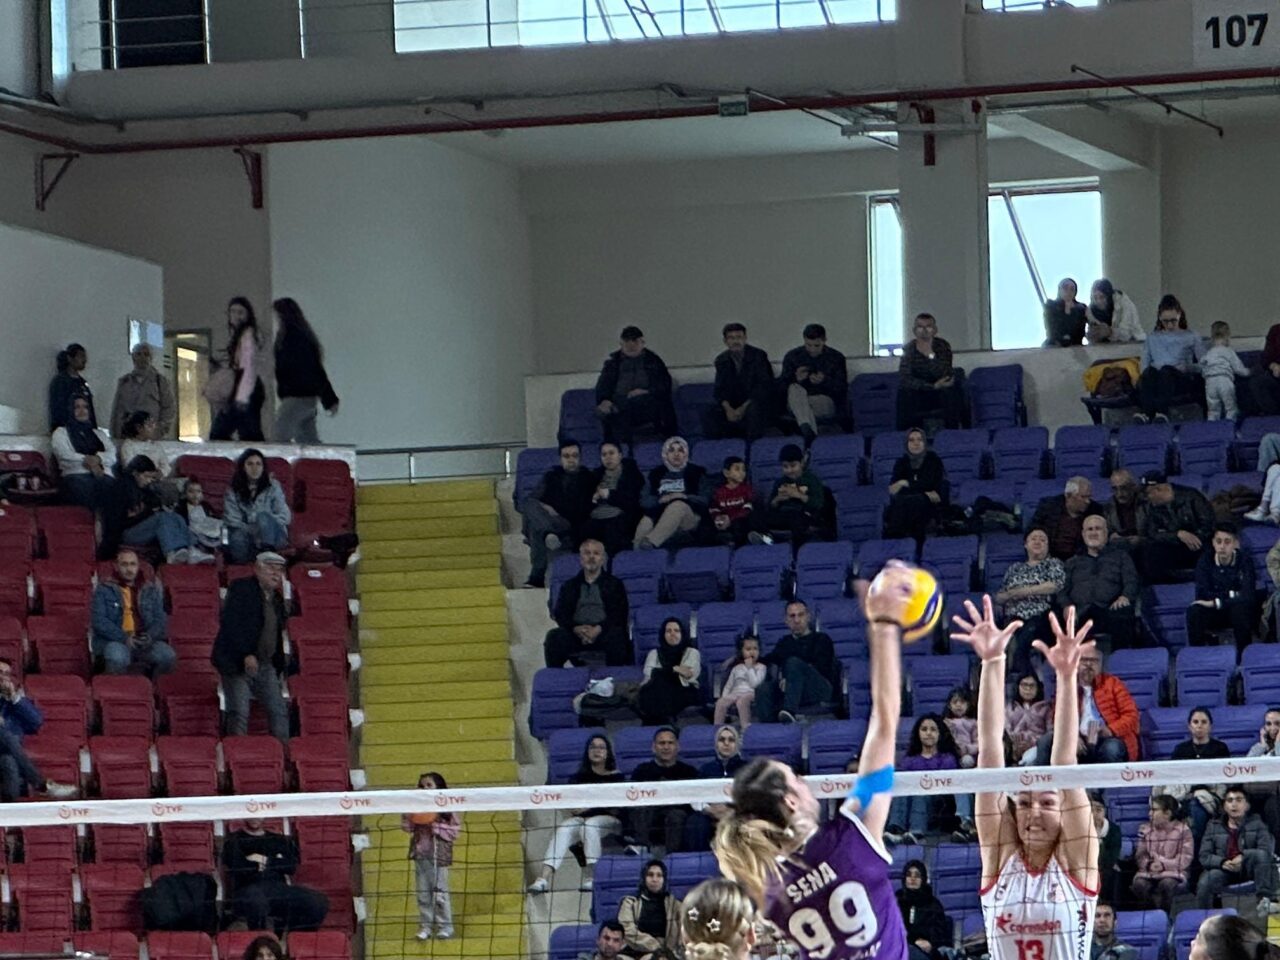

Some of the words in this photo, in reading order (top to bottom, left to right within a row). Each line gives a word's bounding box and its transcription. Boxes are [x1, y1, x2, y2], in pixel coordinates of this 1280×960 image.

[1205, 13, 1268, 49] 107
[1134, 770, 1154, 779] TVF
[1238, 766, 1256, 775] TVF
[934, 778, 952, 787] TVF
[1033, 774, 1052, 783] TVF
[786, 862, 837, 903] SENA
[789, 880, 878, 959] 99
